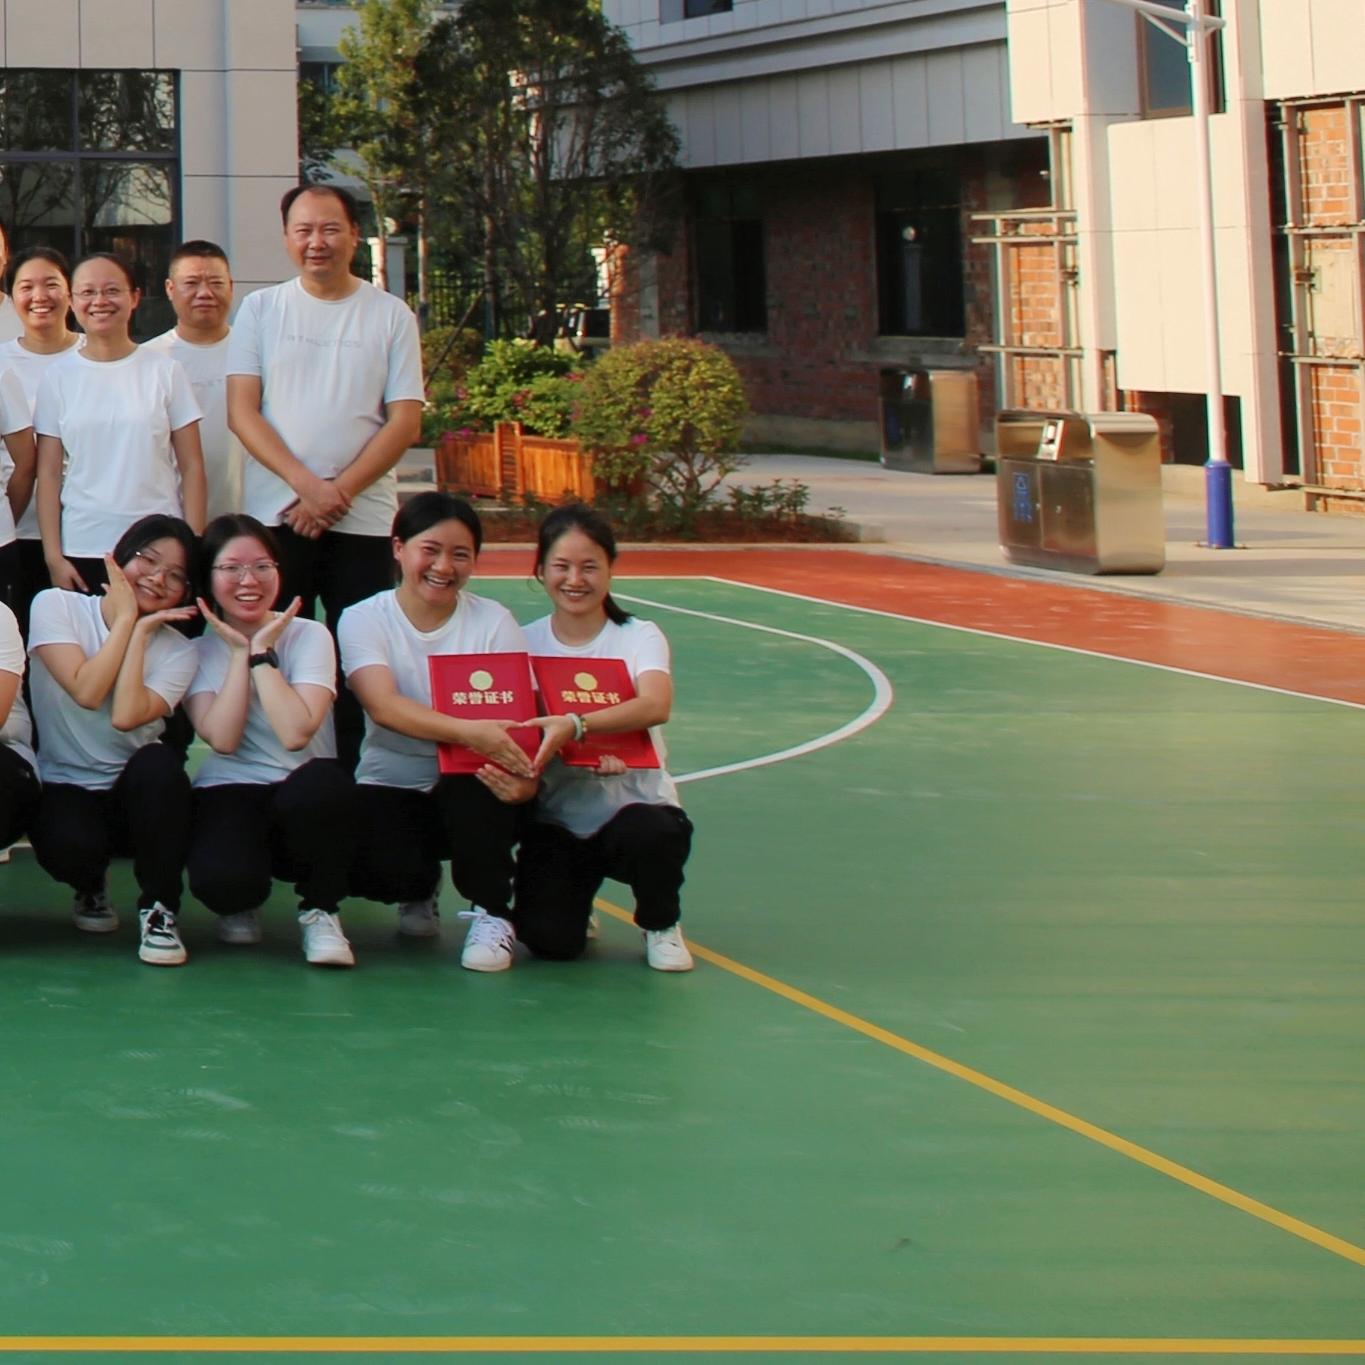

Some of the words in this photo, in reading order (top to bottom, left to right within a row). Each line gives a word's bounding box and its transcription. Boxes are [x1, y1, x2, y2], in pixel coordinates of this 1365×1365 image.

[451, 690, 514, 706] 荣誉证书
[560, 689, 621, 705] 荣誉证书
